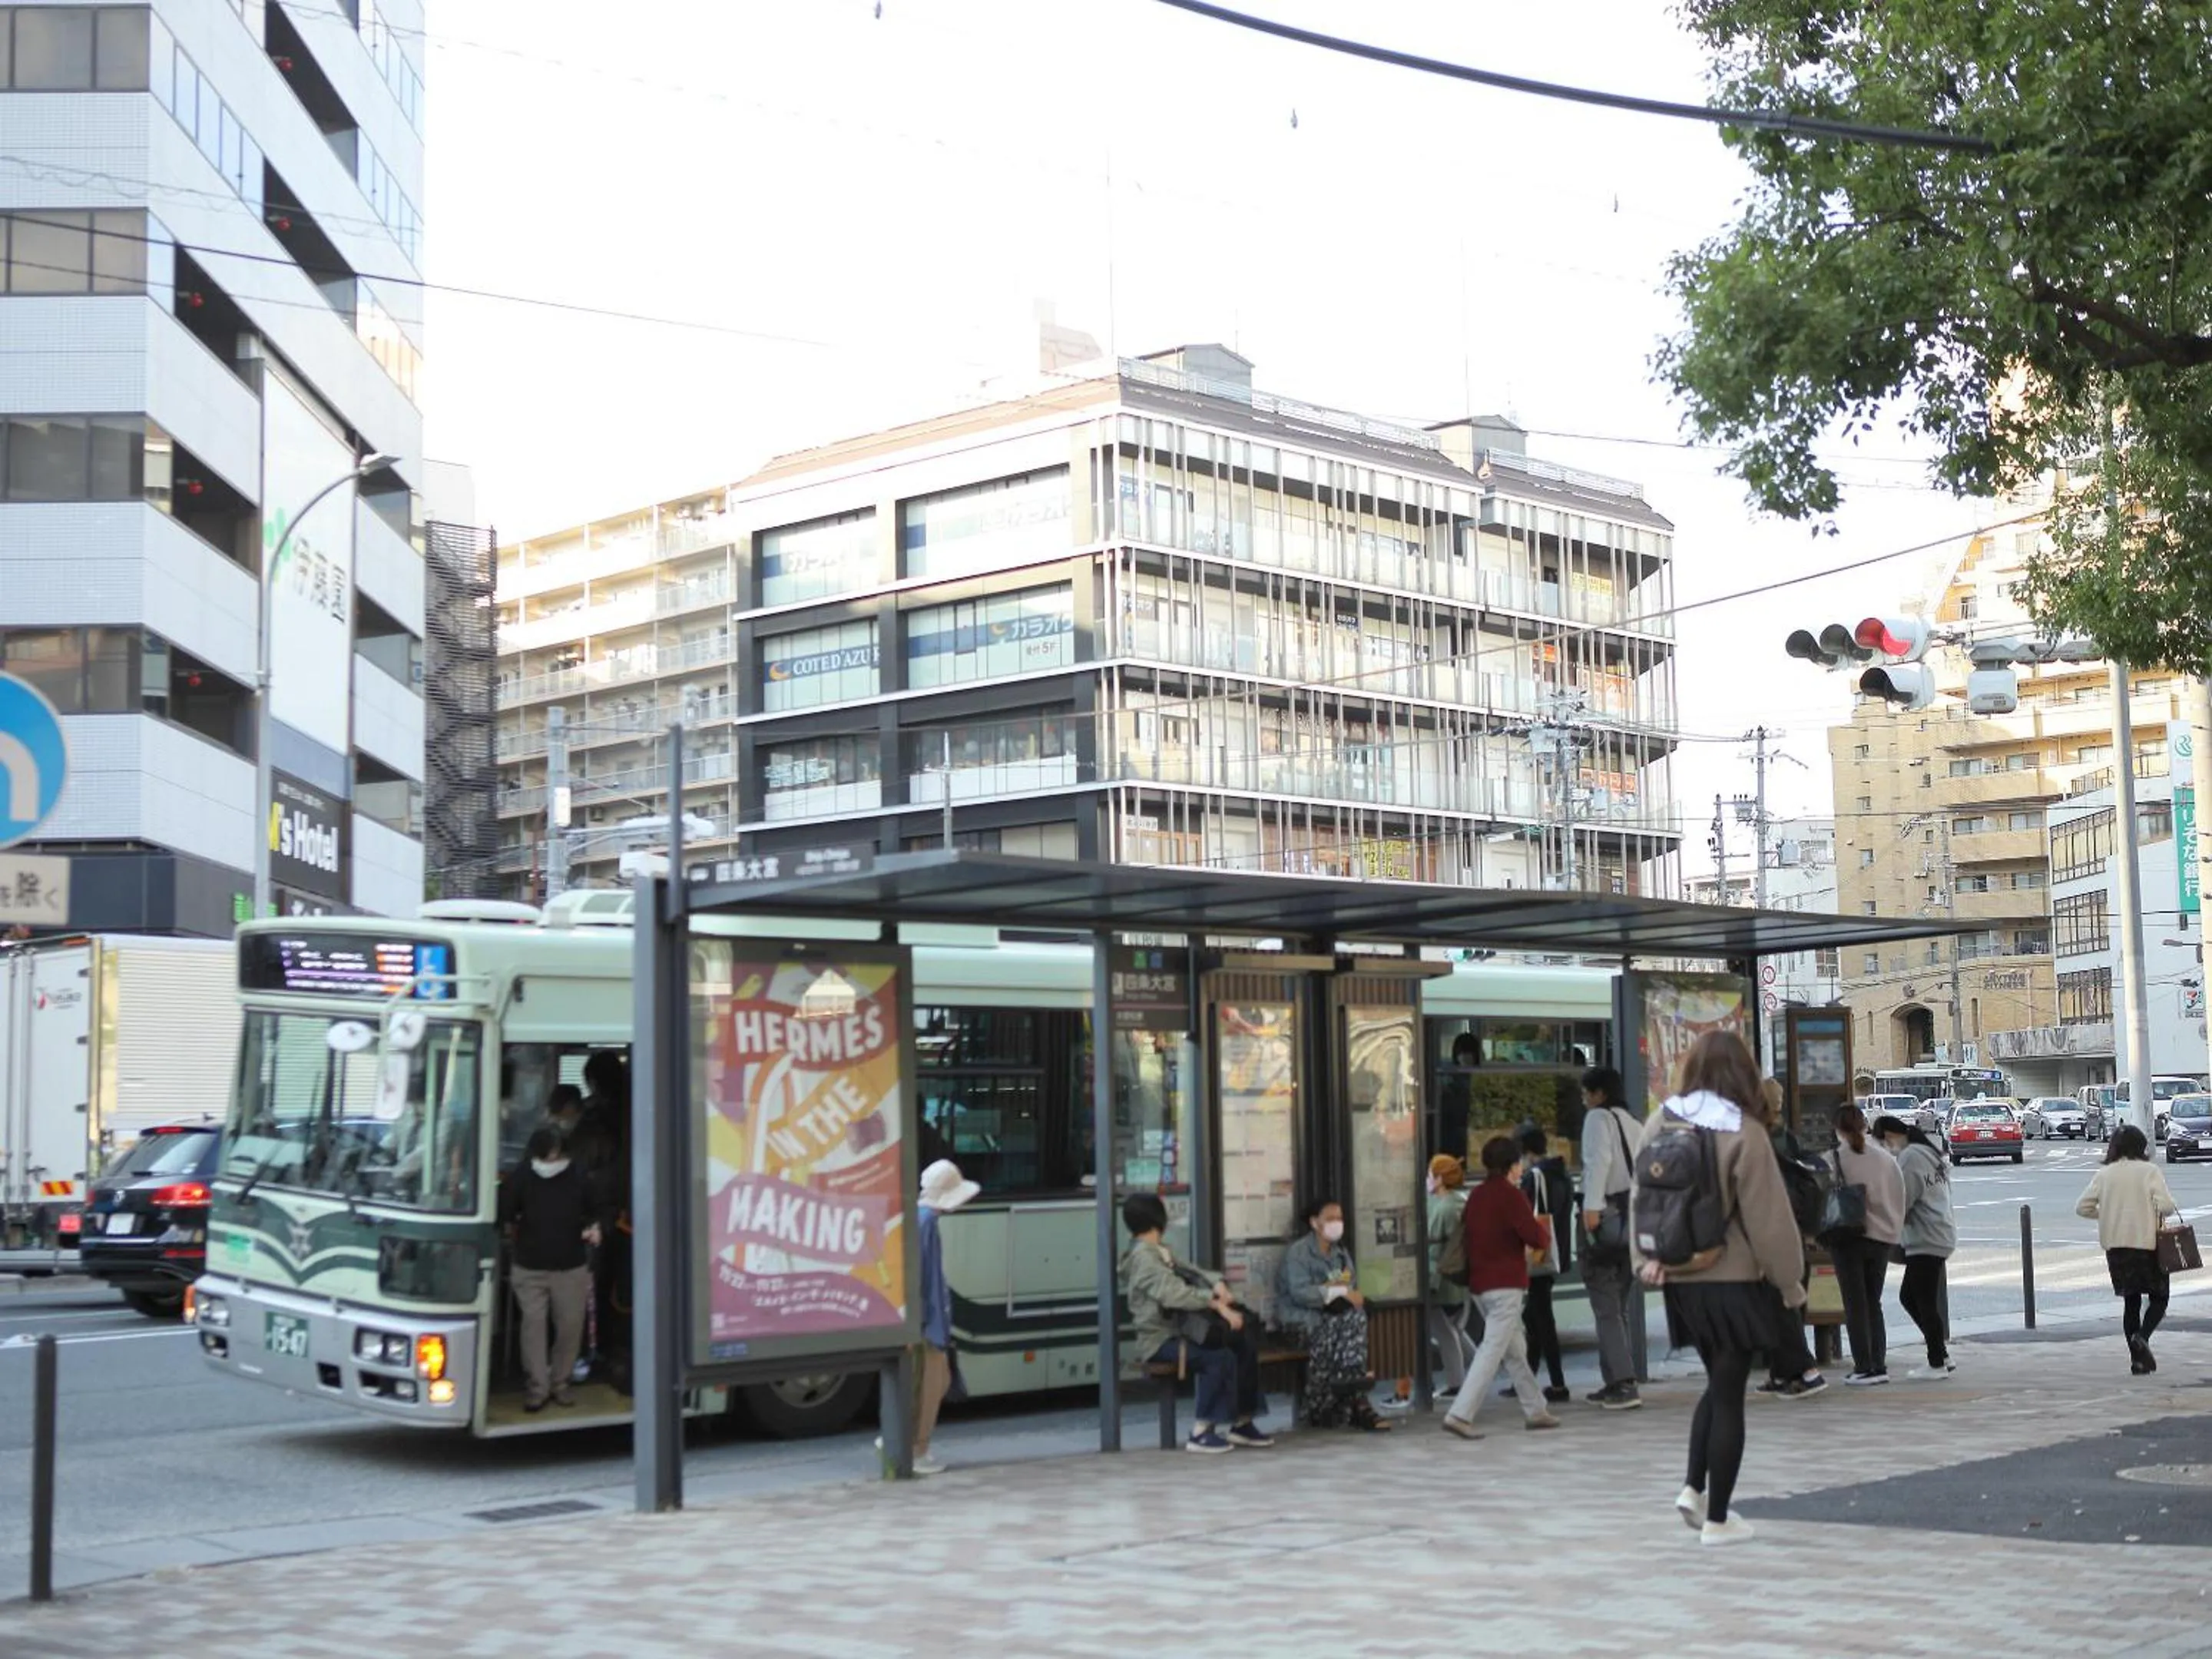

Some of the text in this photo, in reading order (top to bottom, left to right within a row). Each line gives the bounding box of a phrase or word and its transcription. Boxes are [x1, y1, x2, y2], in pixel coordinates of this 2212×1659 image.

[293, 810, 338, 873] Hotel
[734, 1005, 883, 1062] HERMES
[768, 1077, 869, 1161] IN THE
[727, 1185, 866, 1254] MAKING
